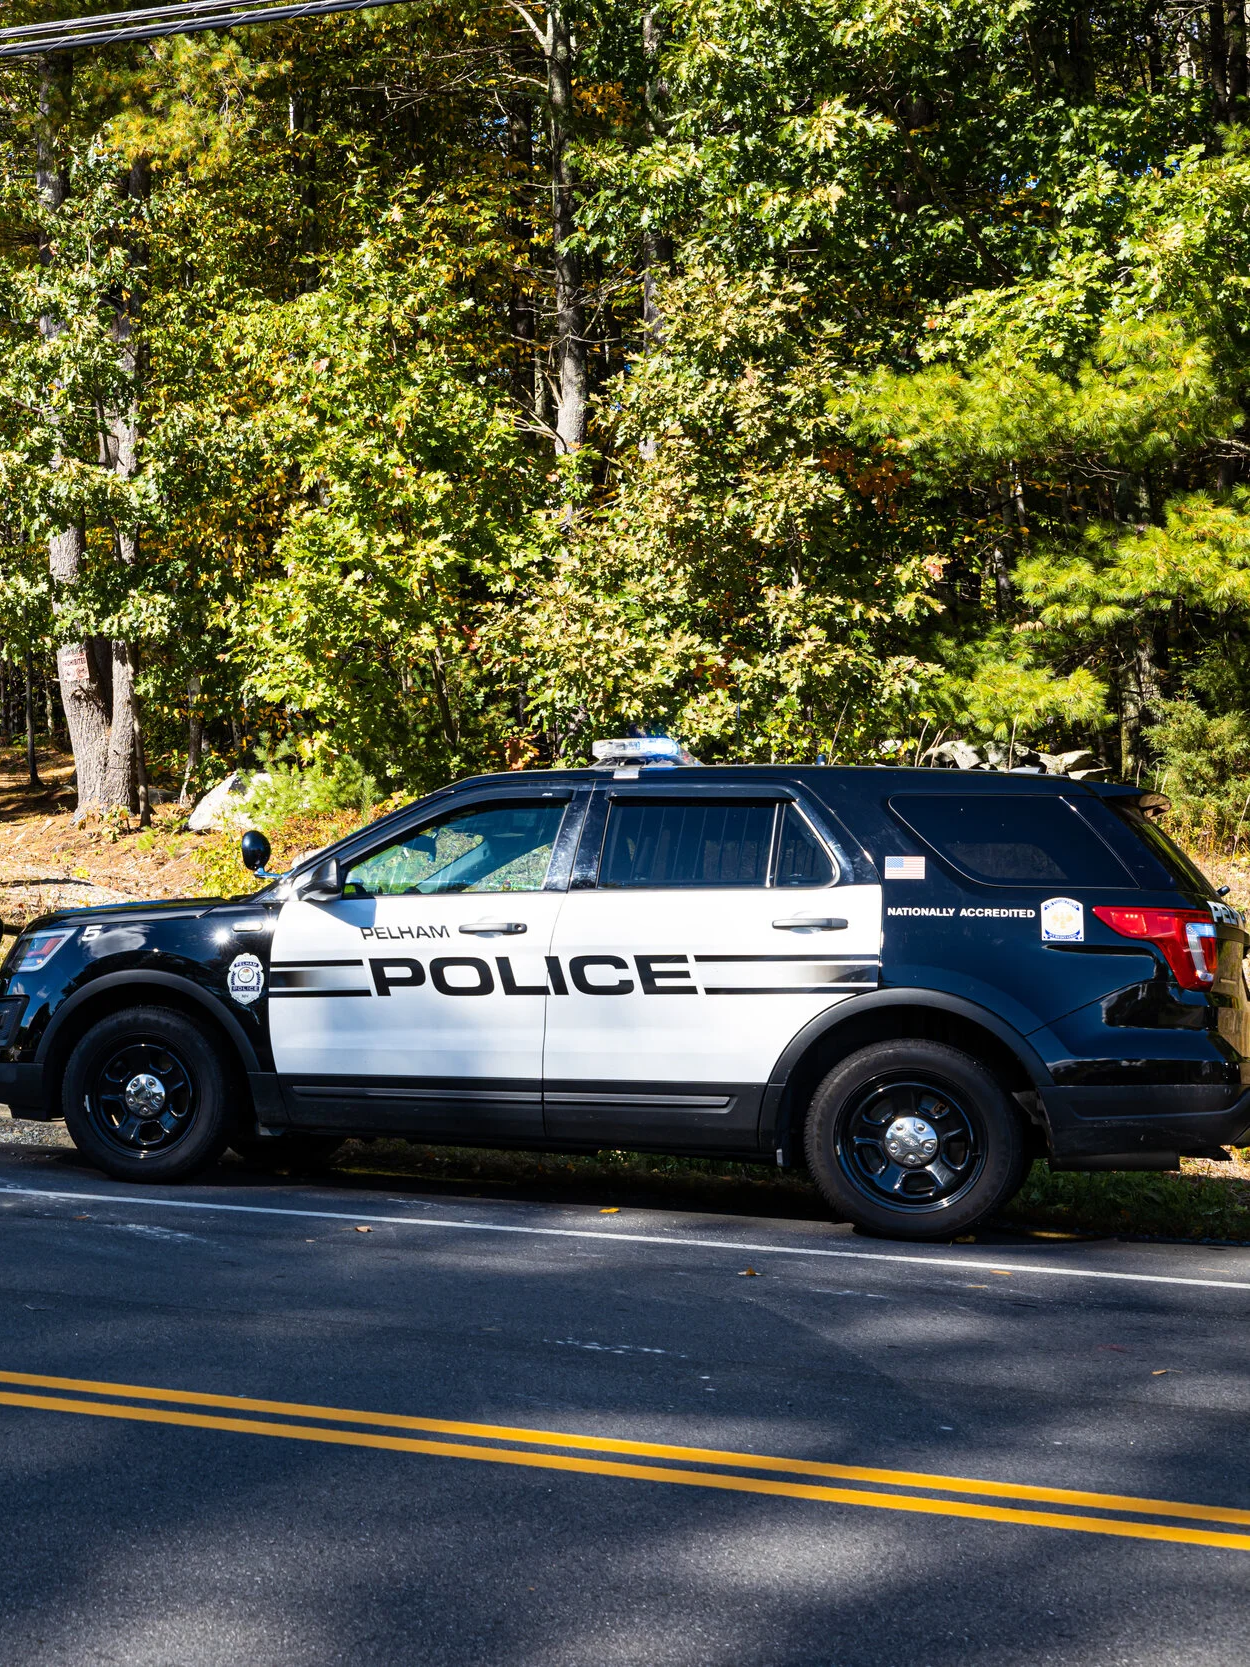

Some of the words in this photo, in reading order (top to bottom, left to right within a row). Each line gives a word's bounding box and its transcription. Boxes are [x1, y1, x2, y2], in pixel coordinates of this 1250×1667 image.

[887, 907, 956, 917] NATIONALLY
[959, 908, 1036, 919] ACCREDITED
[81, 924, 103, 942] 5
[360, 925, 451, 940] PELHAM
[368, 955, 698, 996] POLICE
